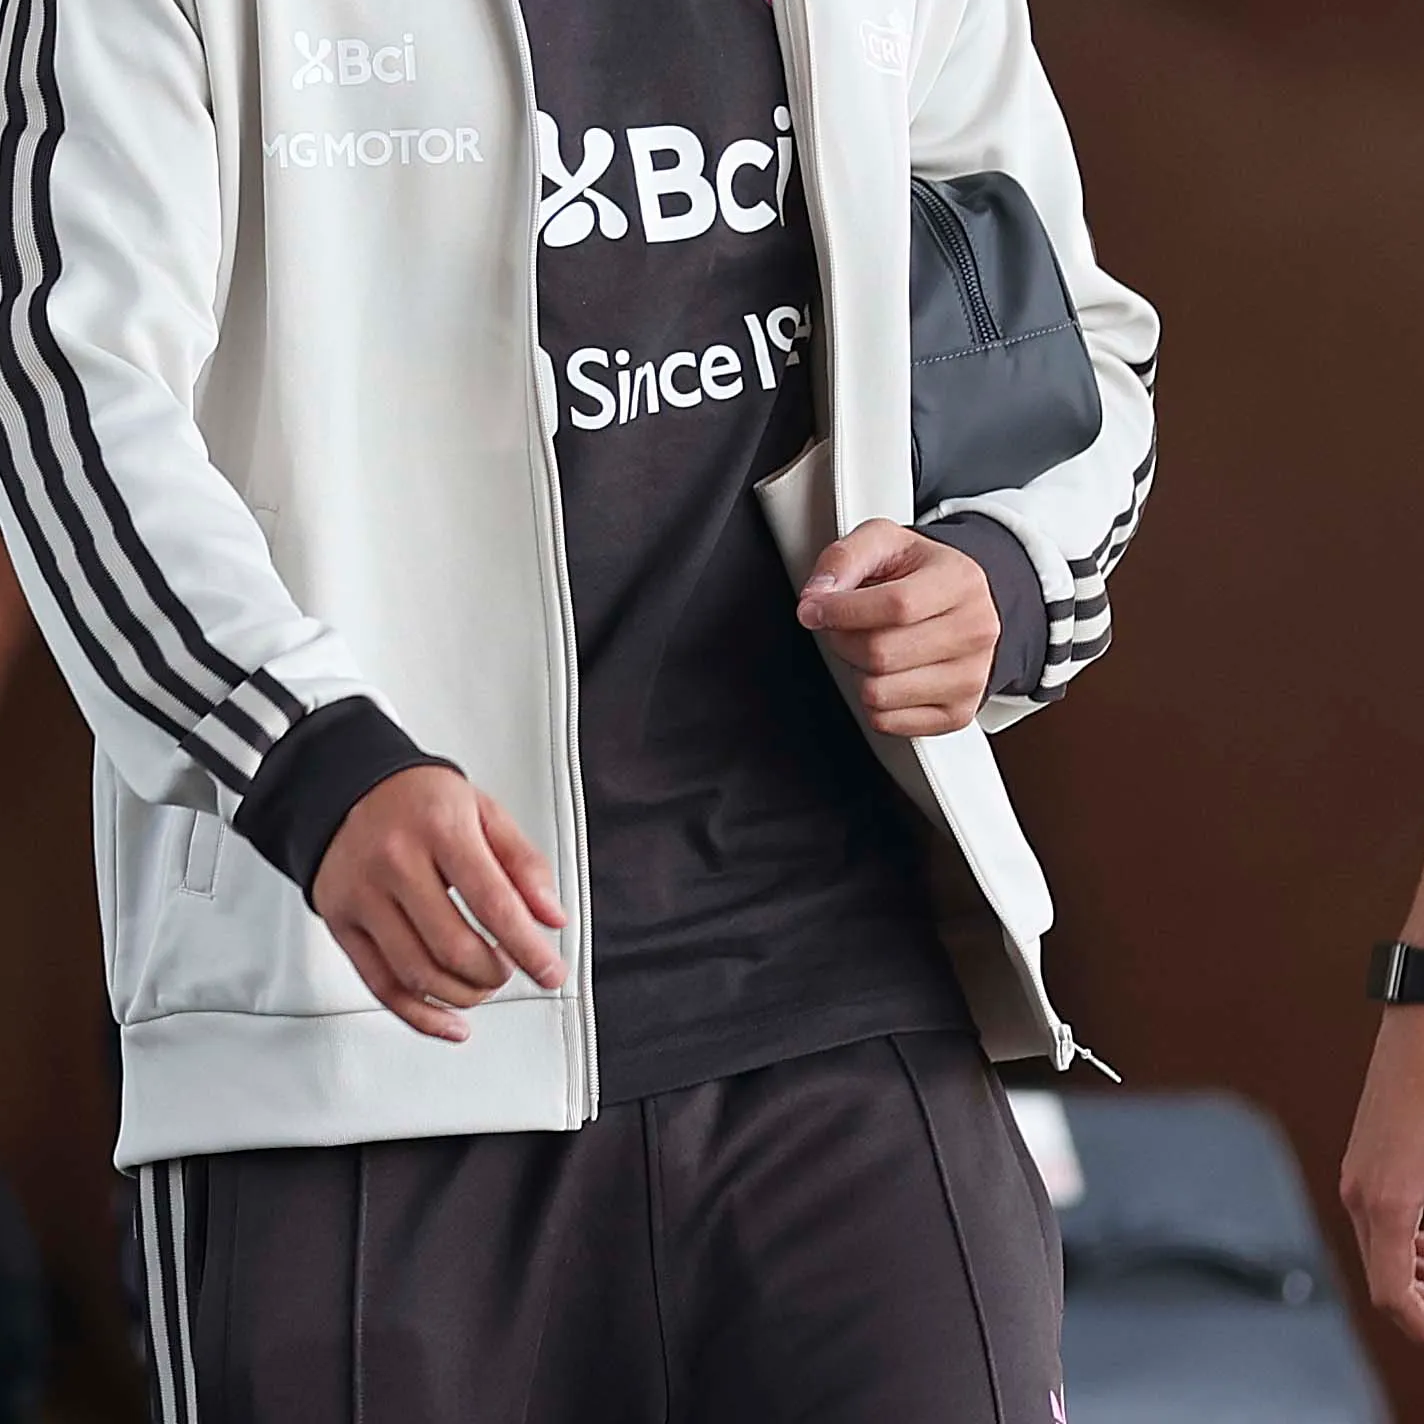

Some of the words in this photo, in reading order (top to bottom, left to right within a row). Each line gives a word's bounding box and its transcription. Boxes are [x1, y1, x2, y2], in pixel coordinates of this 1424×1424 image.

[336, 32, 417, 87] Bci
[625, 105, 793, 244] Bci
[565, 343, 745, 431] Since
[742, 302, 813, 391] 19
